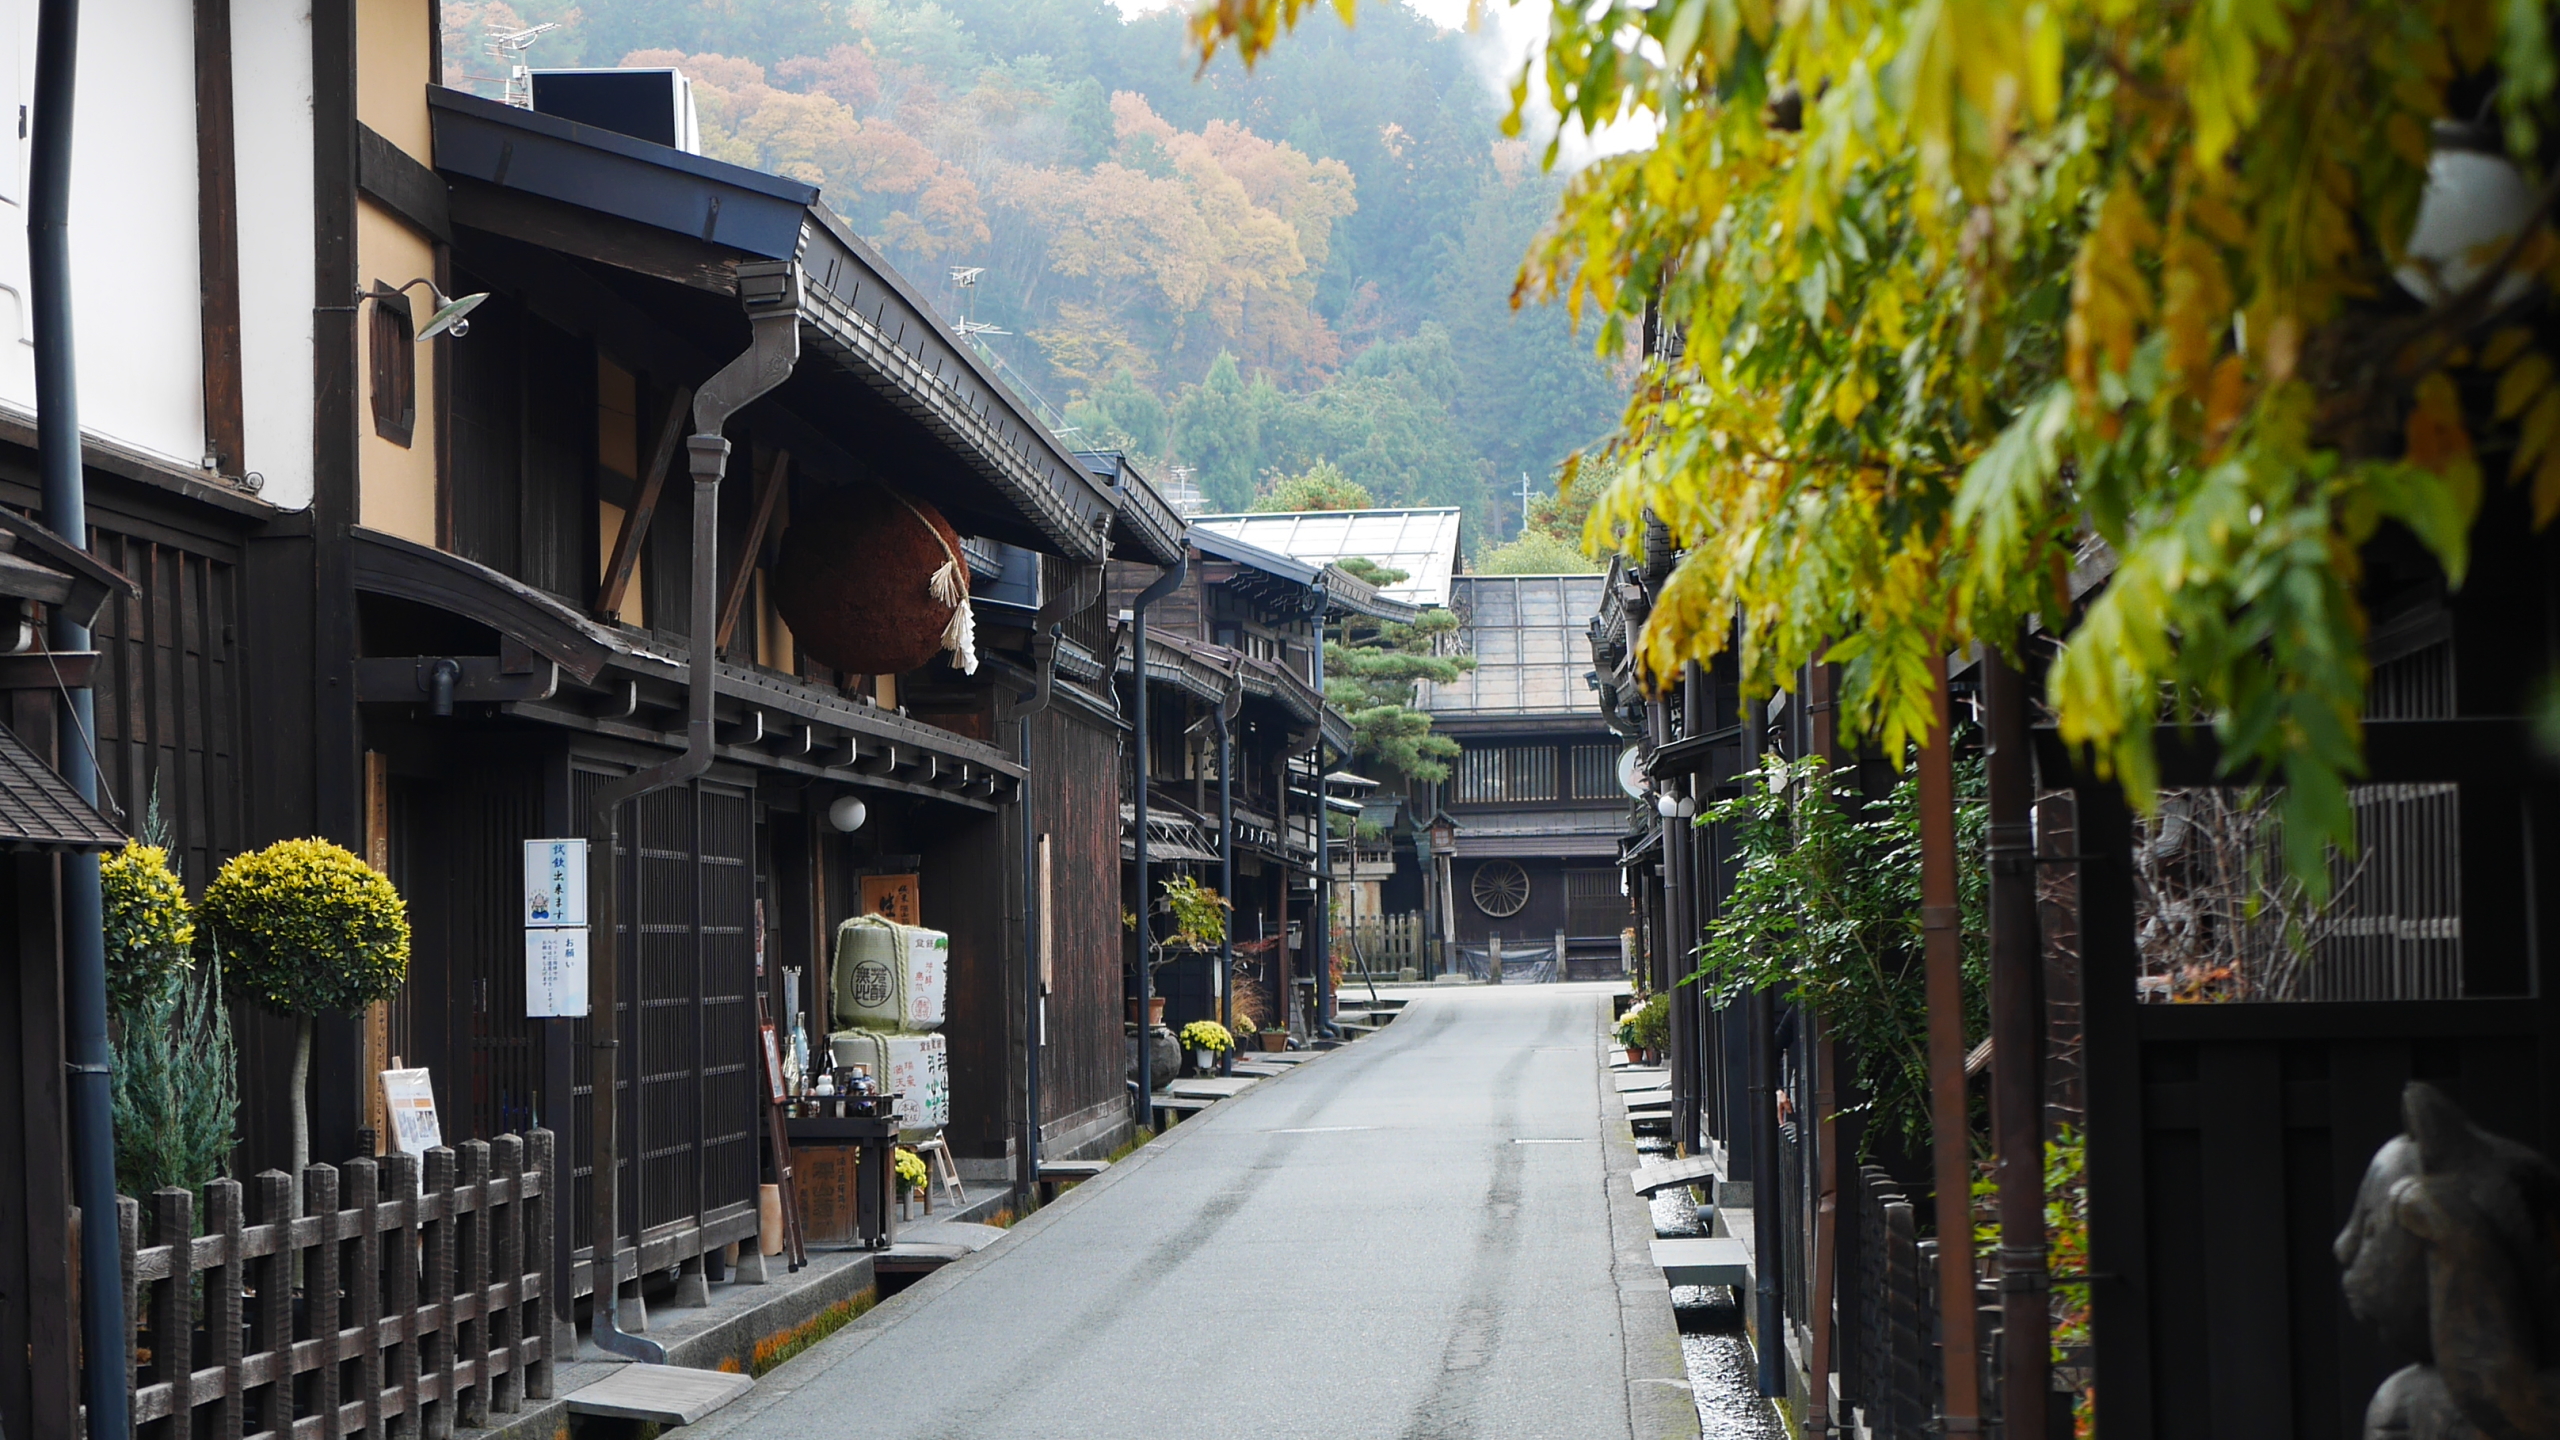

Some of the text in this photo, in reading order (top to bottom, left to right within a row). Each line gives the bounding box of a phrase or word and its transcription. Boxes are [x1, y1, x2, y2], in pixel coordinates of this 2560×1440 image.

[551, 843, 566, 921] 試飲出来ます
[565, 938, 575, 969] お願い
